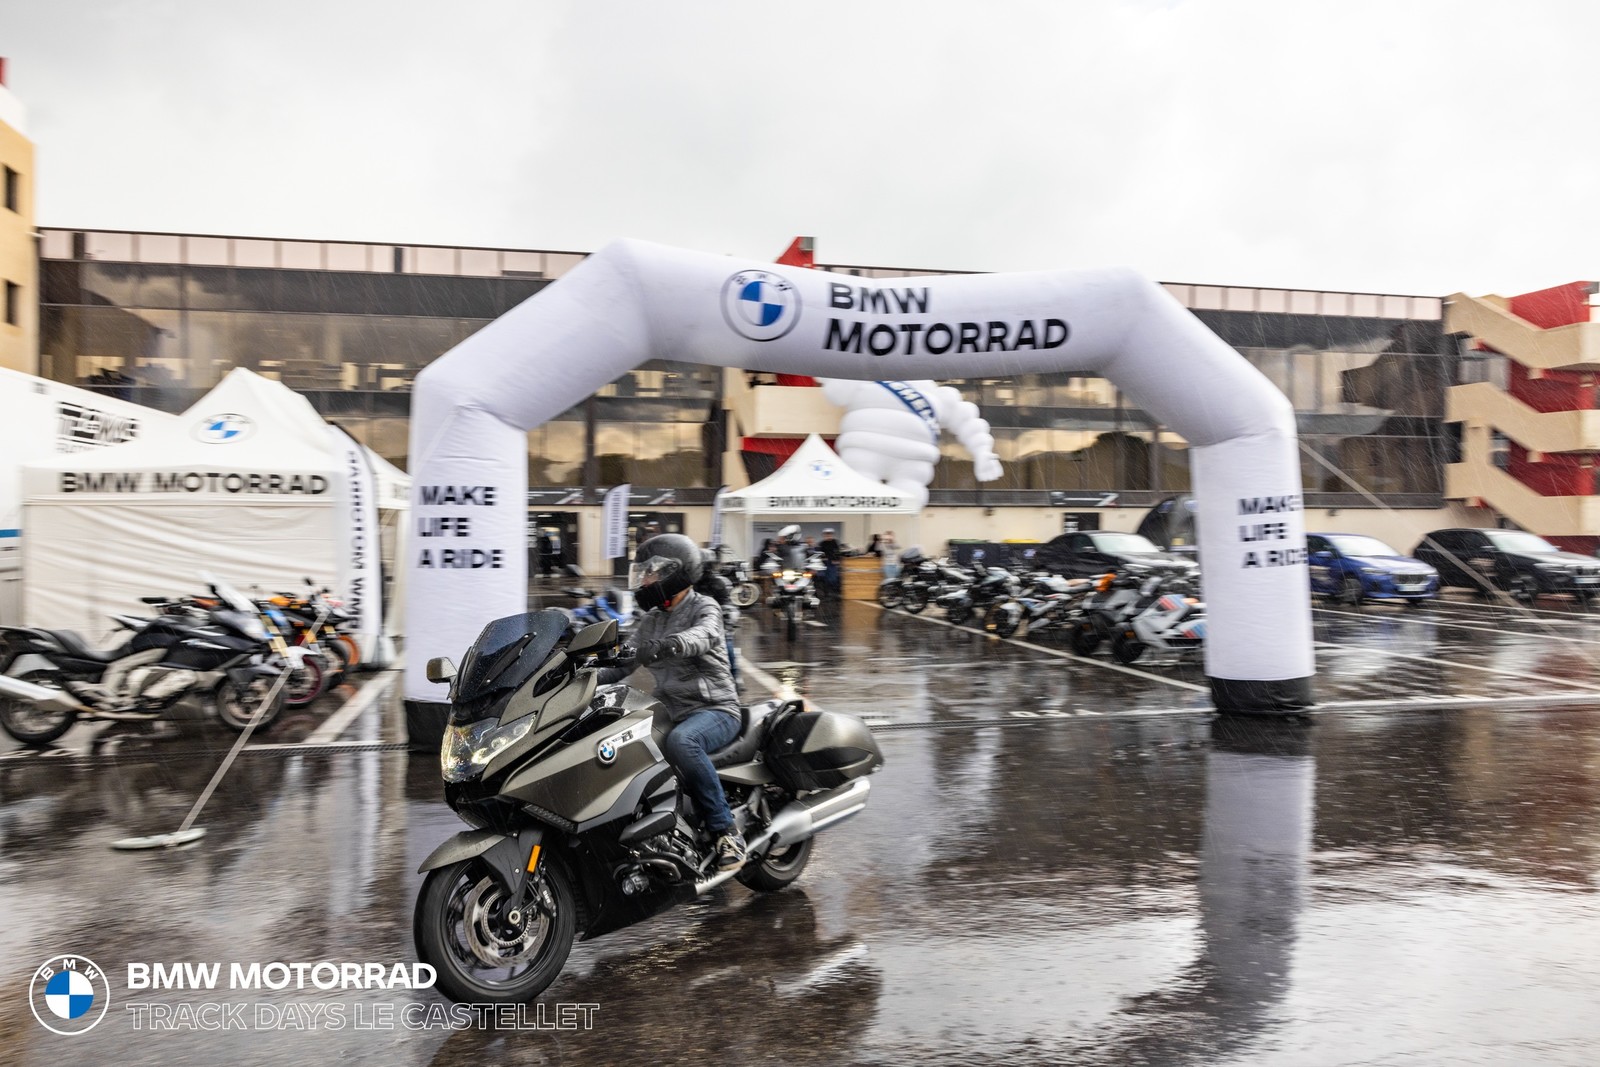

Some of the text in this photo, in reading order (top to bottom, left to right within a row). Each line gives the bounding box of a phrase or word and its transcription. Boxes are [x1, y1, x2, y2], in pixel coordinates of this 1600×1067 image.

[828, 281, 931, 314] BMW
[822, 318, 1073, 356] MOTORRAD
[60, 472, 327, 494] BMW MOTORRAD
[419, 486, 497, 505] MAKE
[768, 495, 902, 508] BMW MOTORRAD
[1238, 494, 1303, 515] MAKE
[418, 517, 470, 537] LIFE
[1239, 522, 1288, 541] LIFE
[417, 549, 504, 568] A RIDE
[1241, 551, 1262, 568] A
